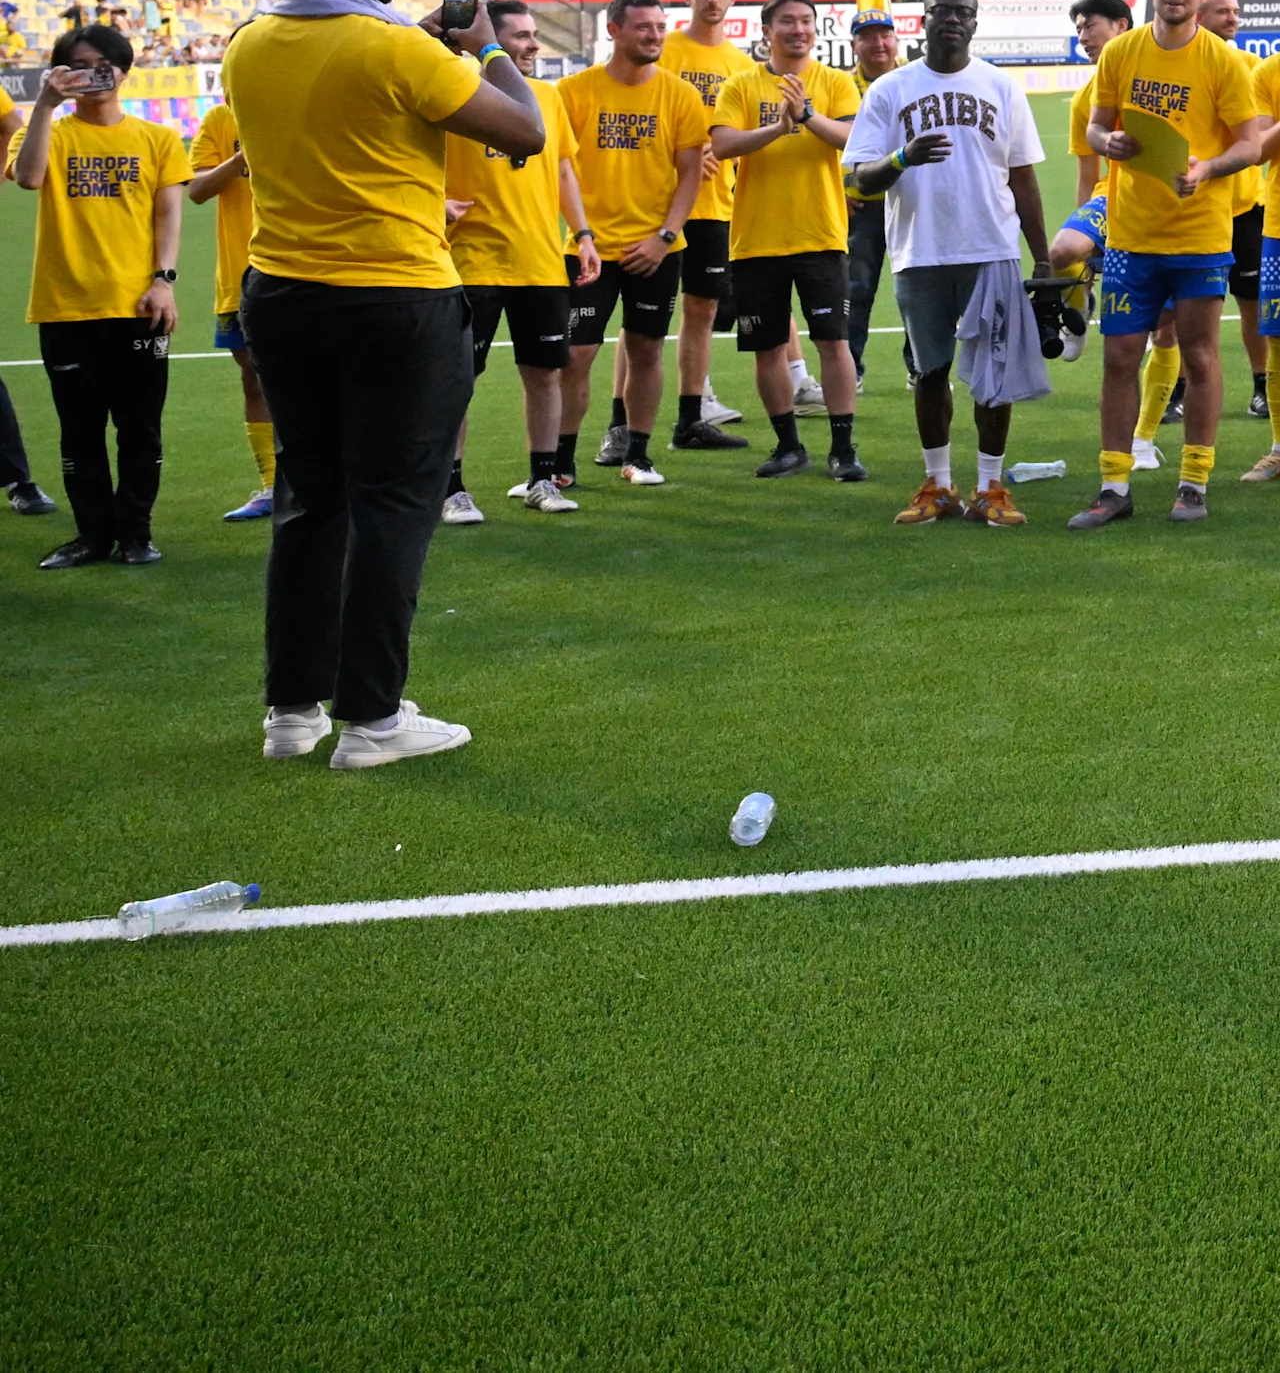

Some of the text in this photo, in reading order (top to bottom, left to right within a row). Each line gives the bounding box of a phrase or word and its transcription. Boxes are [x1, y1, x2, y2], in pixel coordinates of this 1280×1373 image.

[1132, 79, 1191, 100] EUROPE
[1130, 92, 1189, 112] HERE WE
[599, 113, 657, 127] EUROPE
[898, 91, 999, 143] TRIBE
[598, 125, 657, 138] HERE WE
[597, 137, 640, 150] COME
[68, 157, 140, 170] EUROPE
[67, 170, 140, 183] HERE WE
[67, 182, 121, 198] COME
[1108, 292, 1132, 315] 14
[580, 306, 596, 317] RB
[133, 339, 152, 350] SY
